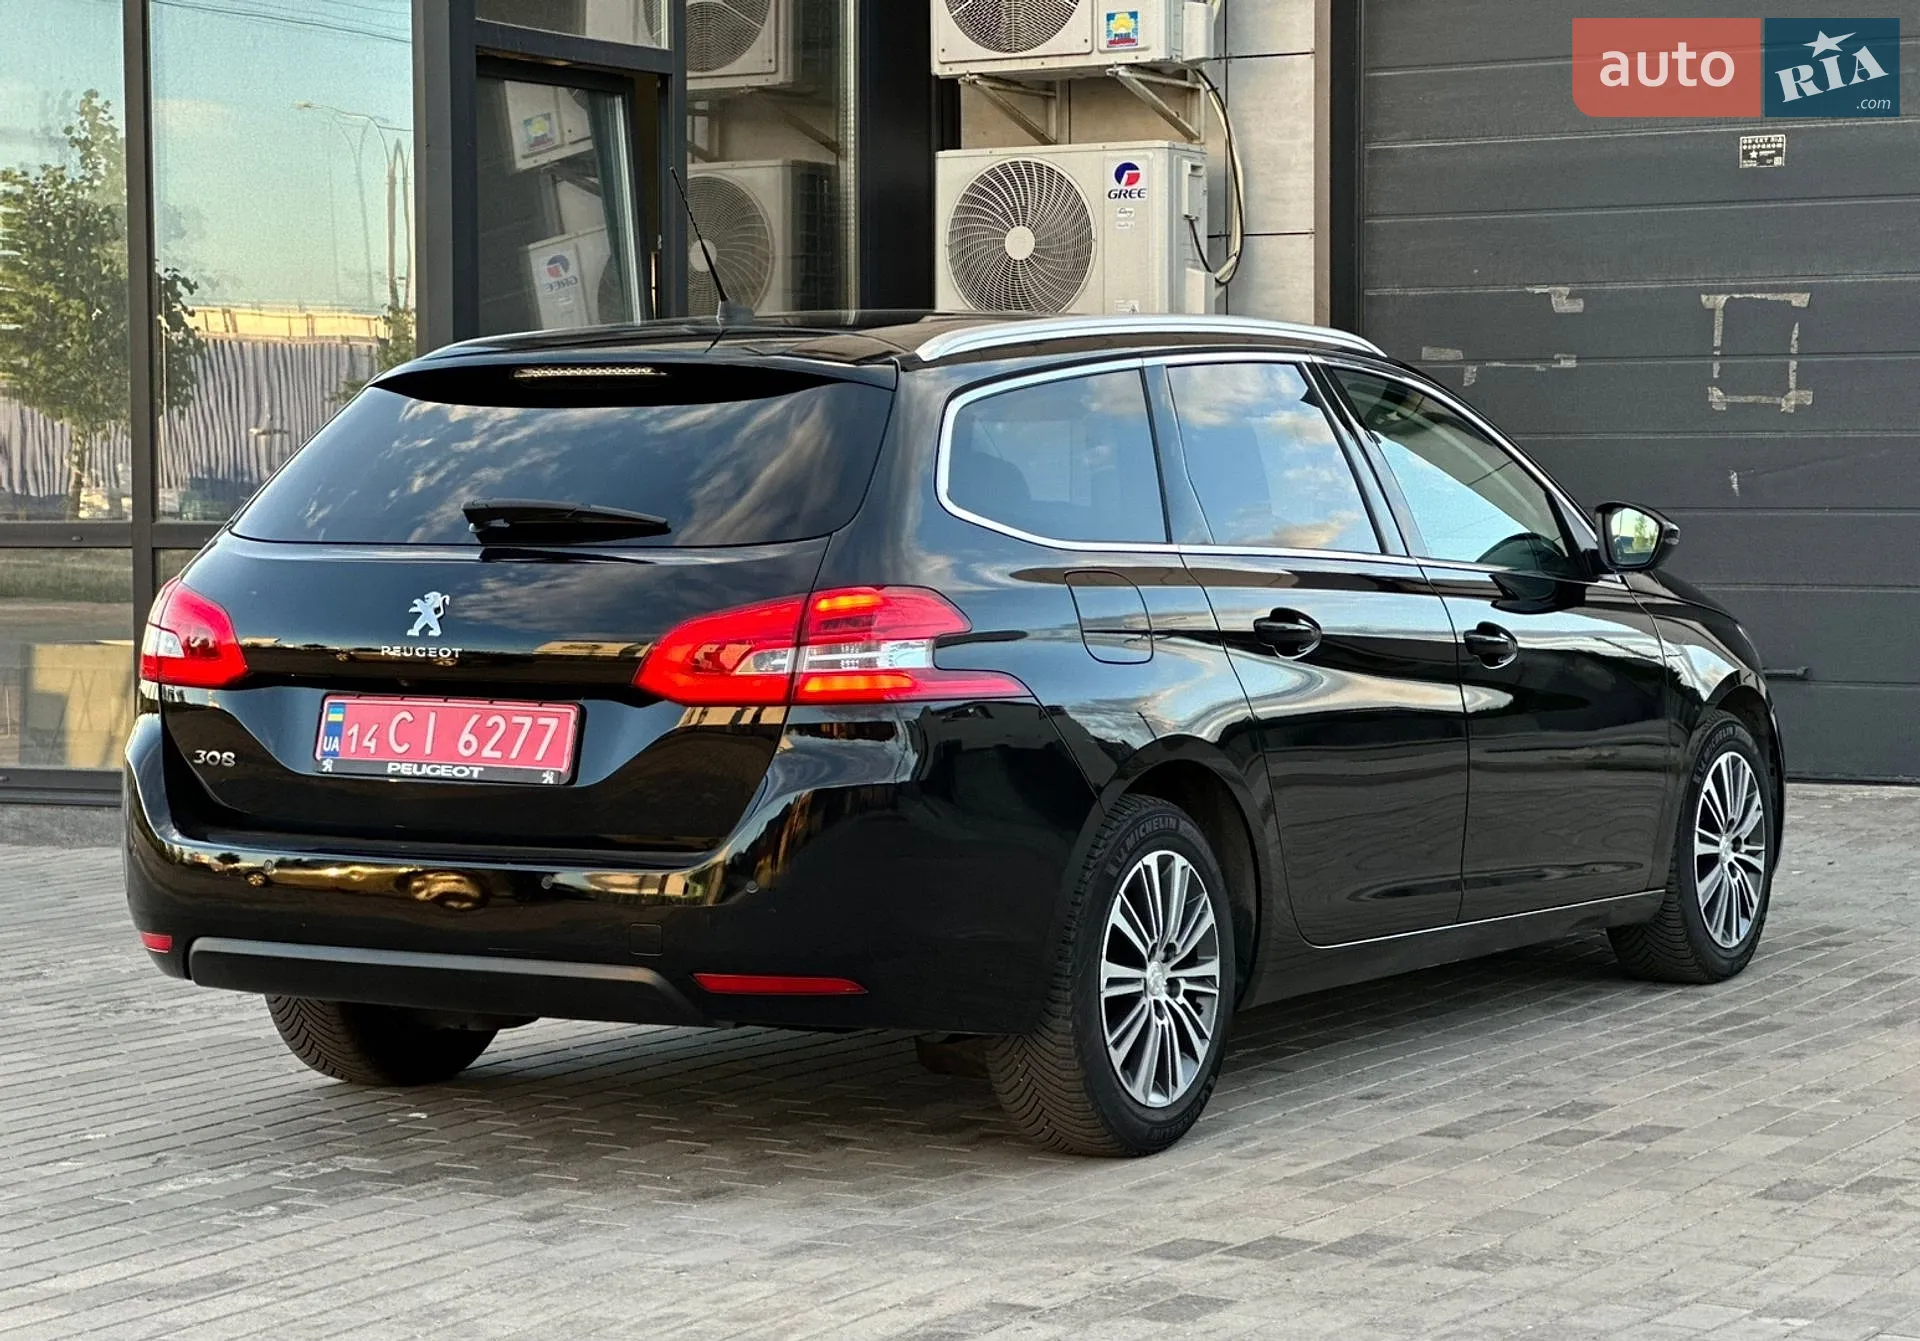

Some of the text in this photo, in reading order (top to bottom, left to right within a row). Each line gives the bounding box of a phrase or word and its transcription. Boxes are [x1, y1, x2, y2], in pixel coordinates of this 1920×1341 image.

[1108, 187, 1147, 200] GREE
[381, 645, 463, 659] PEUGEOT
[323, 736, 340, 752] UA
[347, 711, 560, 761] 14 CI 6277
[193, 749, 236, 767] 308
[387, 761, 484, 779] PEUGEOT
[1125, 817, 1178, 851] MICHELIN
